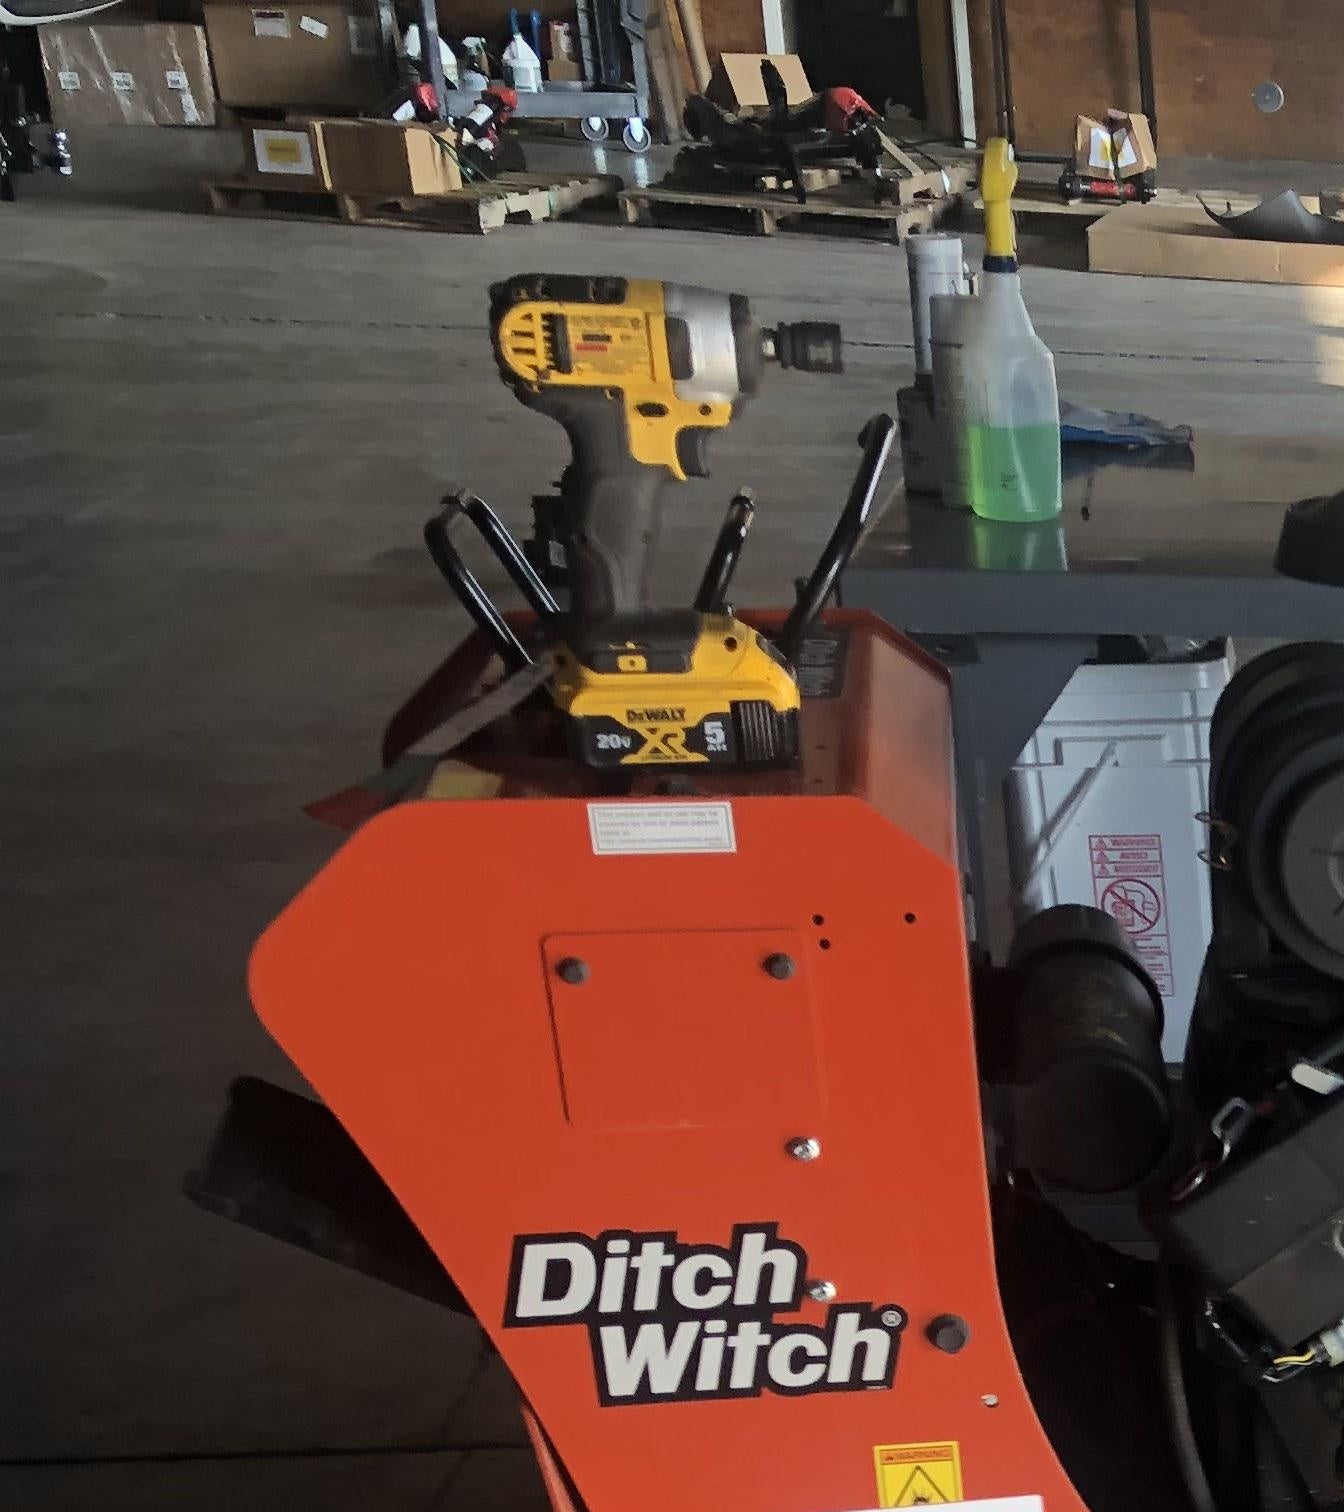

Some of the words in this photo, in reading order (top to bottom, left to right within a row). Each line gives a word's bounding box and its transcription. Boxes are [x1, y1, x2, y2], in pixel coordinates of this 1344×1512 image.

[704, 721, 726, 745] 5
[514, 1232, 798, 1318] Ditch
[599, 1311, 892, 1397] Witch
